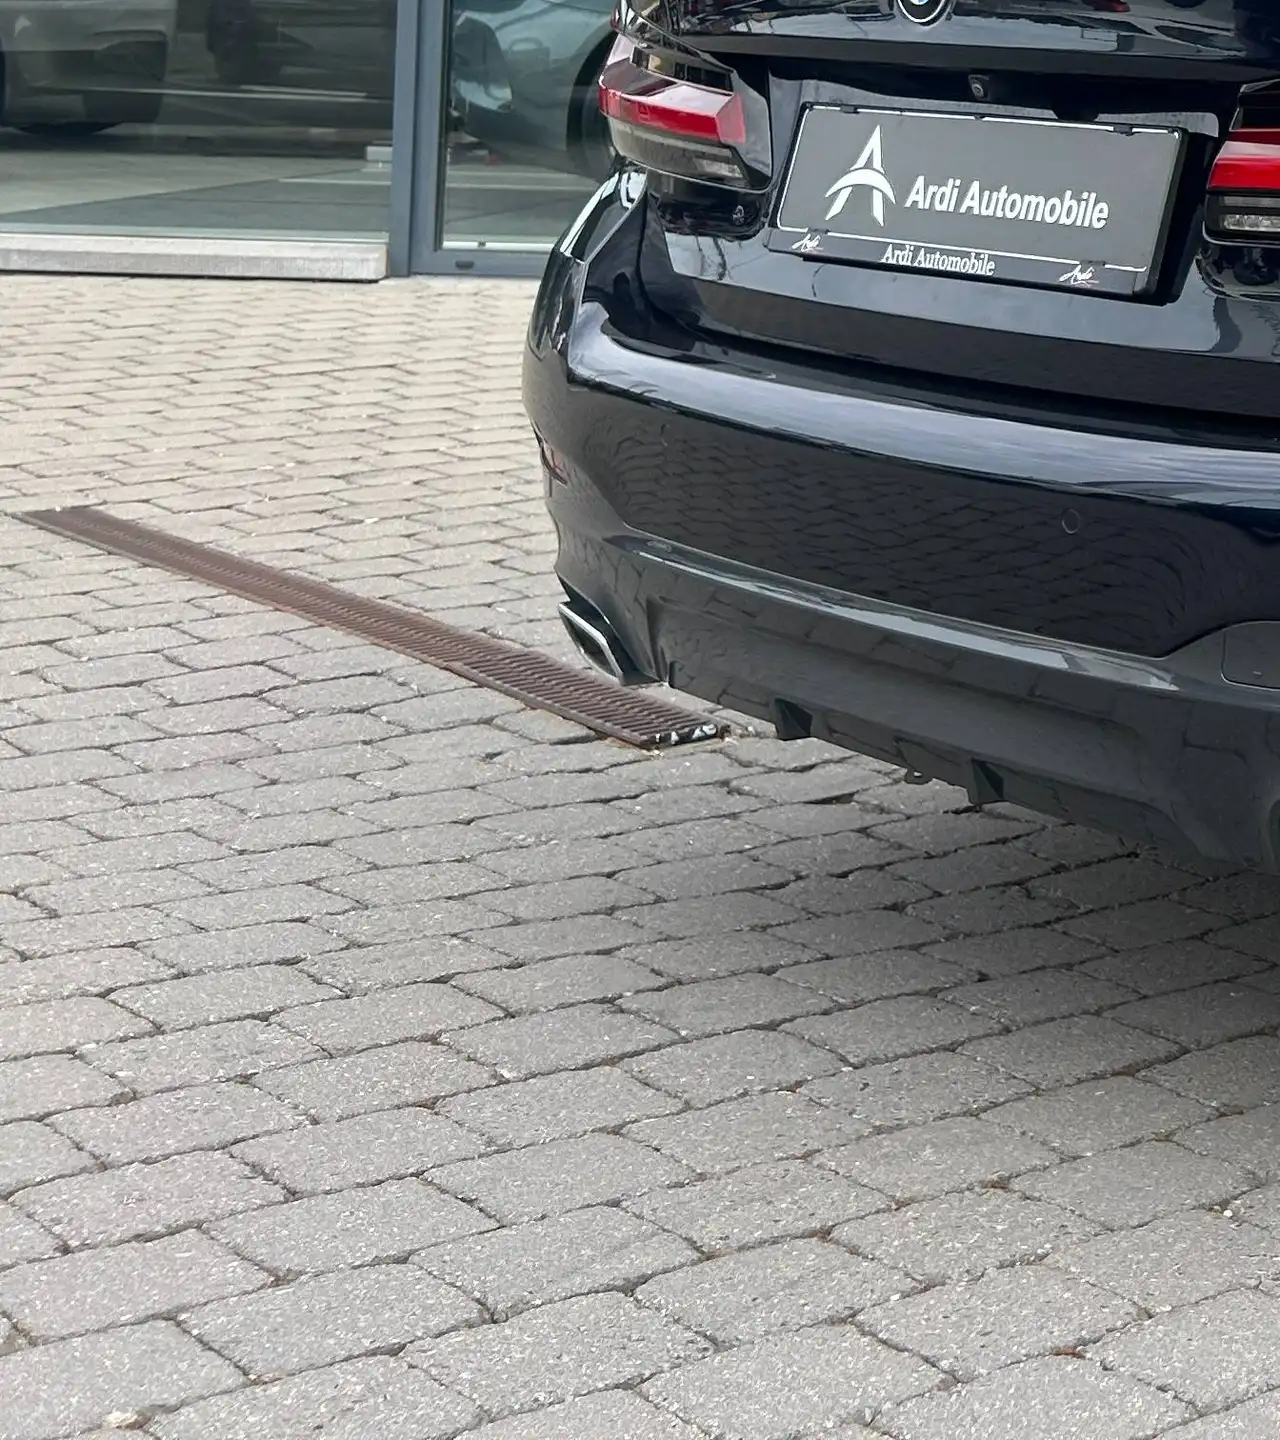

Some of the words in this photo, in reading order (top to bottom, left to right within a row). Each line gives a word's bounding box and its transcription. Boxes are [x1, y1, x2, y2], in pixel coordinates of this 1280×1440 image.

[904, 175, 962, 213] Ardi
[960, 180, 1109, 229] Automobile
[881, 244, 914, 264] Ardi
[914, 247, 996, 276] Automobile
